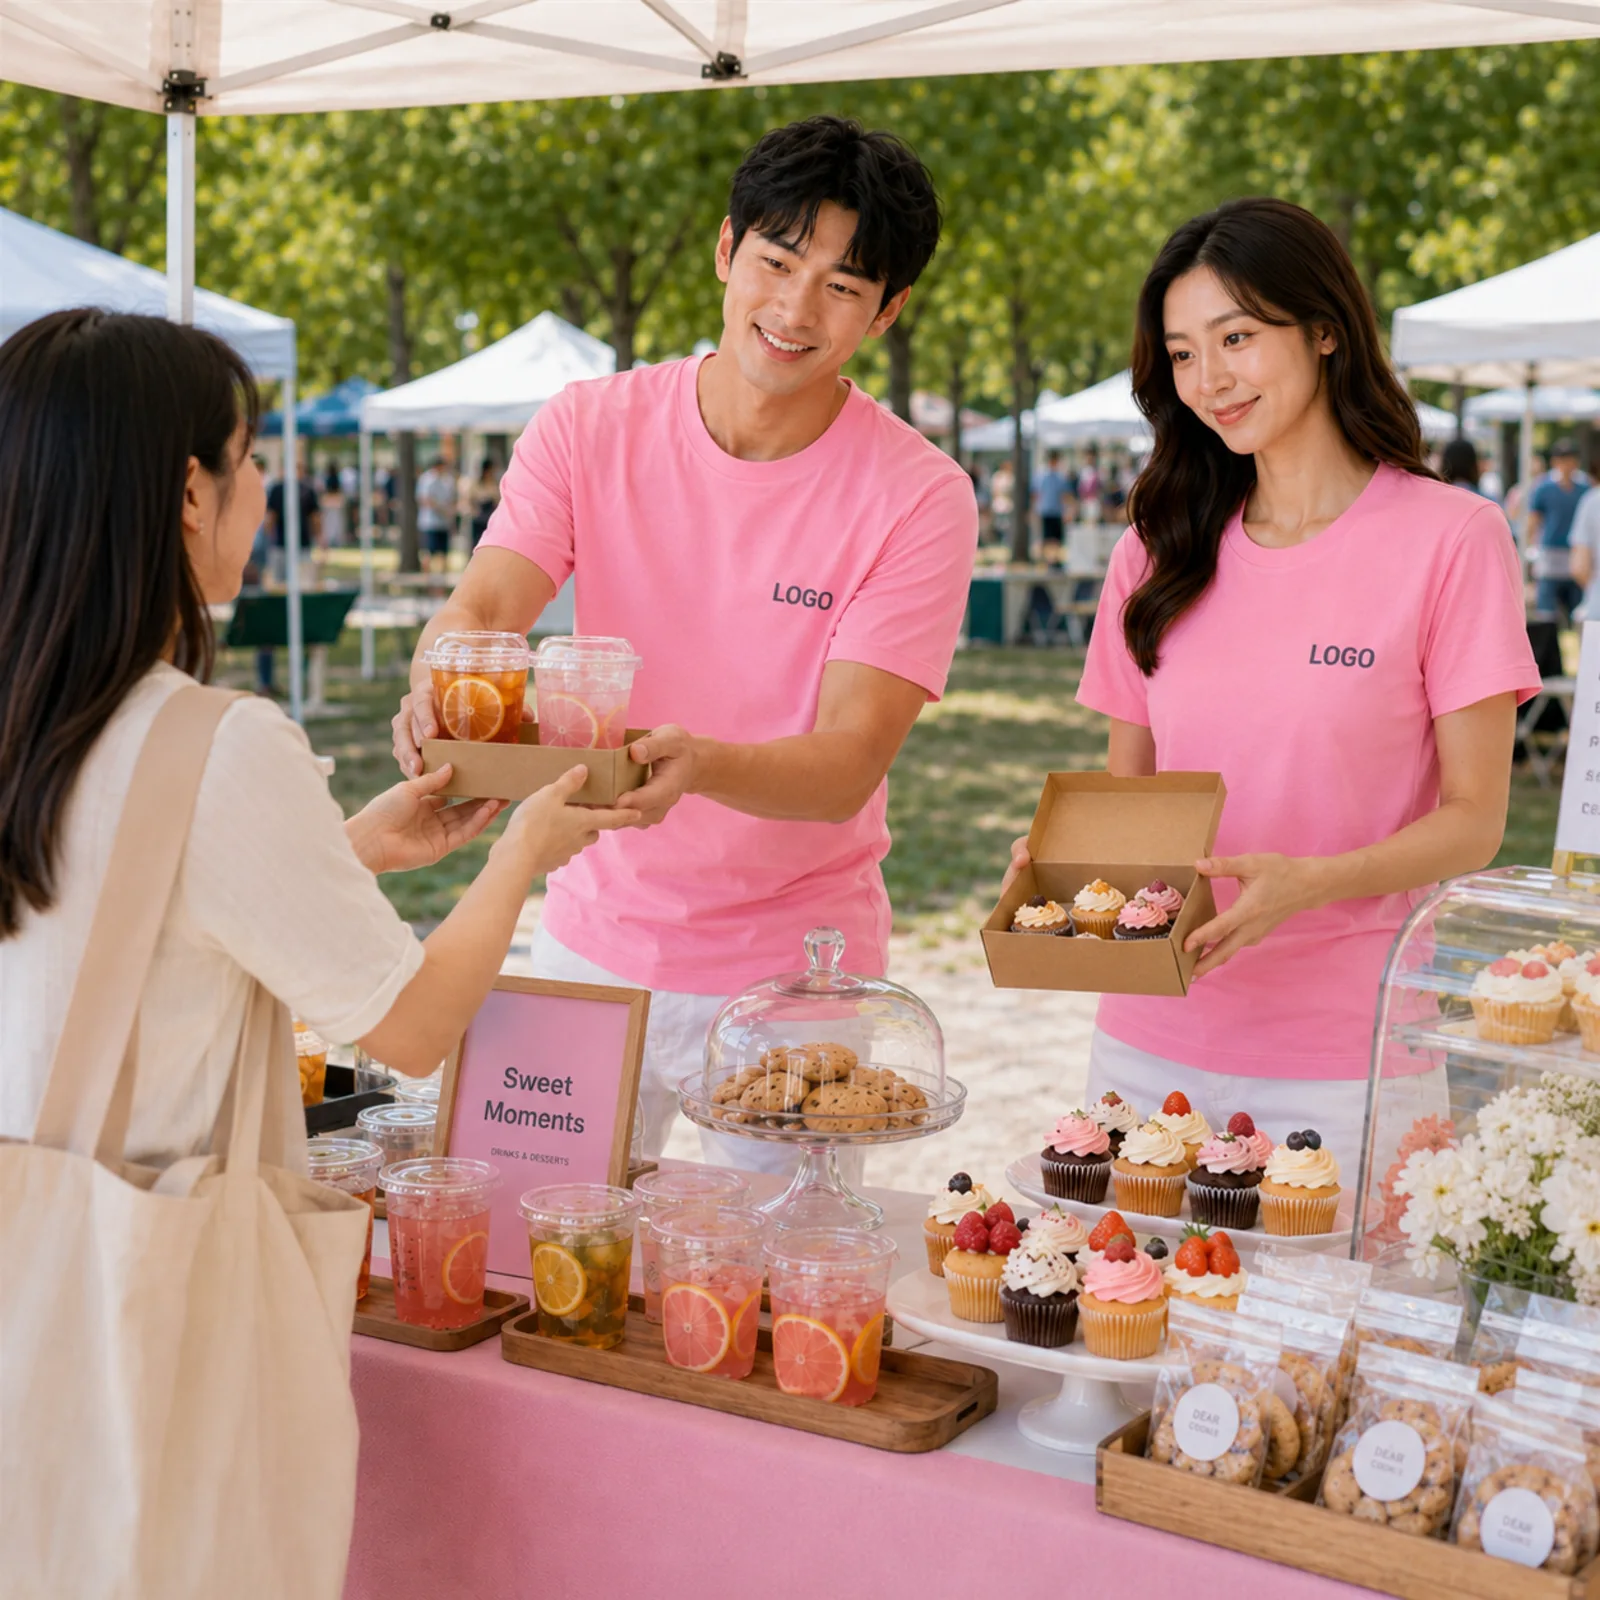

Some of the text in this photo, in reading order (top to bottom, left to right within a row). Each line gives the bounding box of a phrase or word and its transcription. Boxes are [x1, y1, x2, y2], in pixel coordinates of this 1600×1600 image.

[773, 582, 833, 610] LOGO
[1309, 644, 1375, 669] LOGO
[503, 1066, 573, 1096] Sweet
[484, 1099, 585, 1134] Moments
[490, 1147, 570, 1166] DRINKS & DESSERTS
[1192, 1408, 1221, 1425] DEAR
